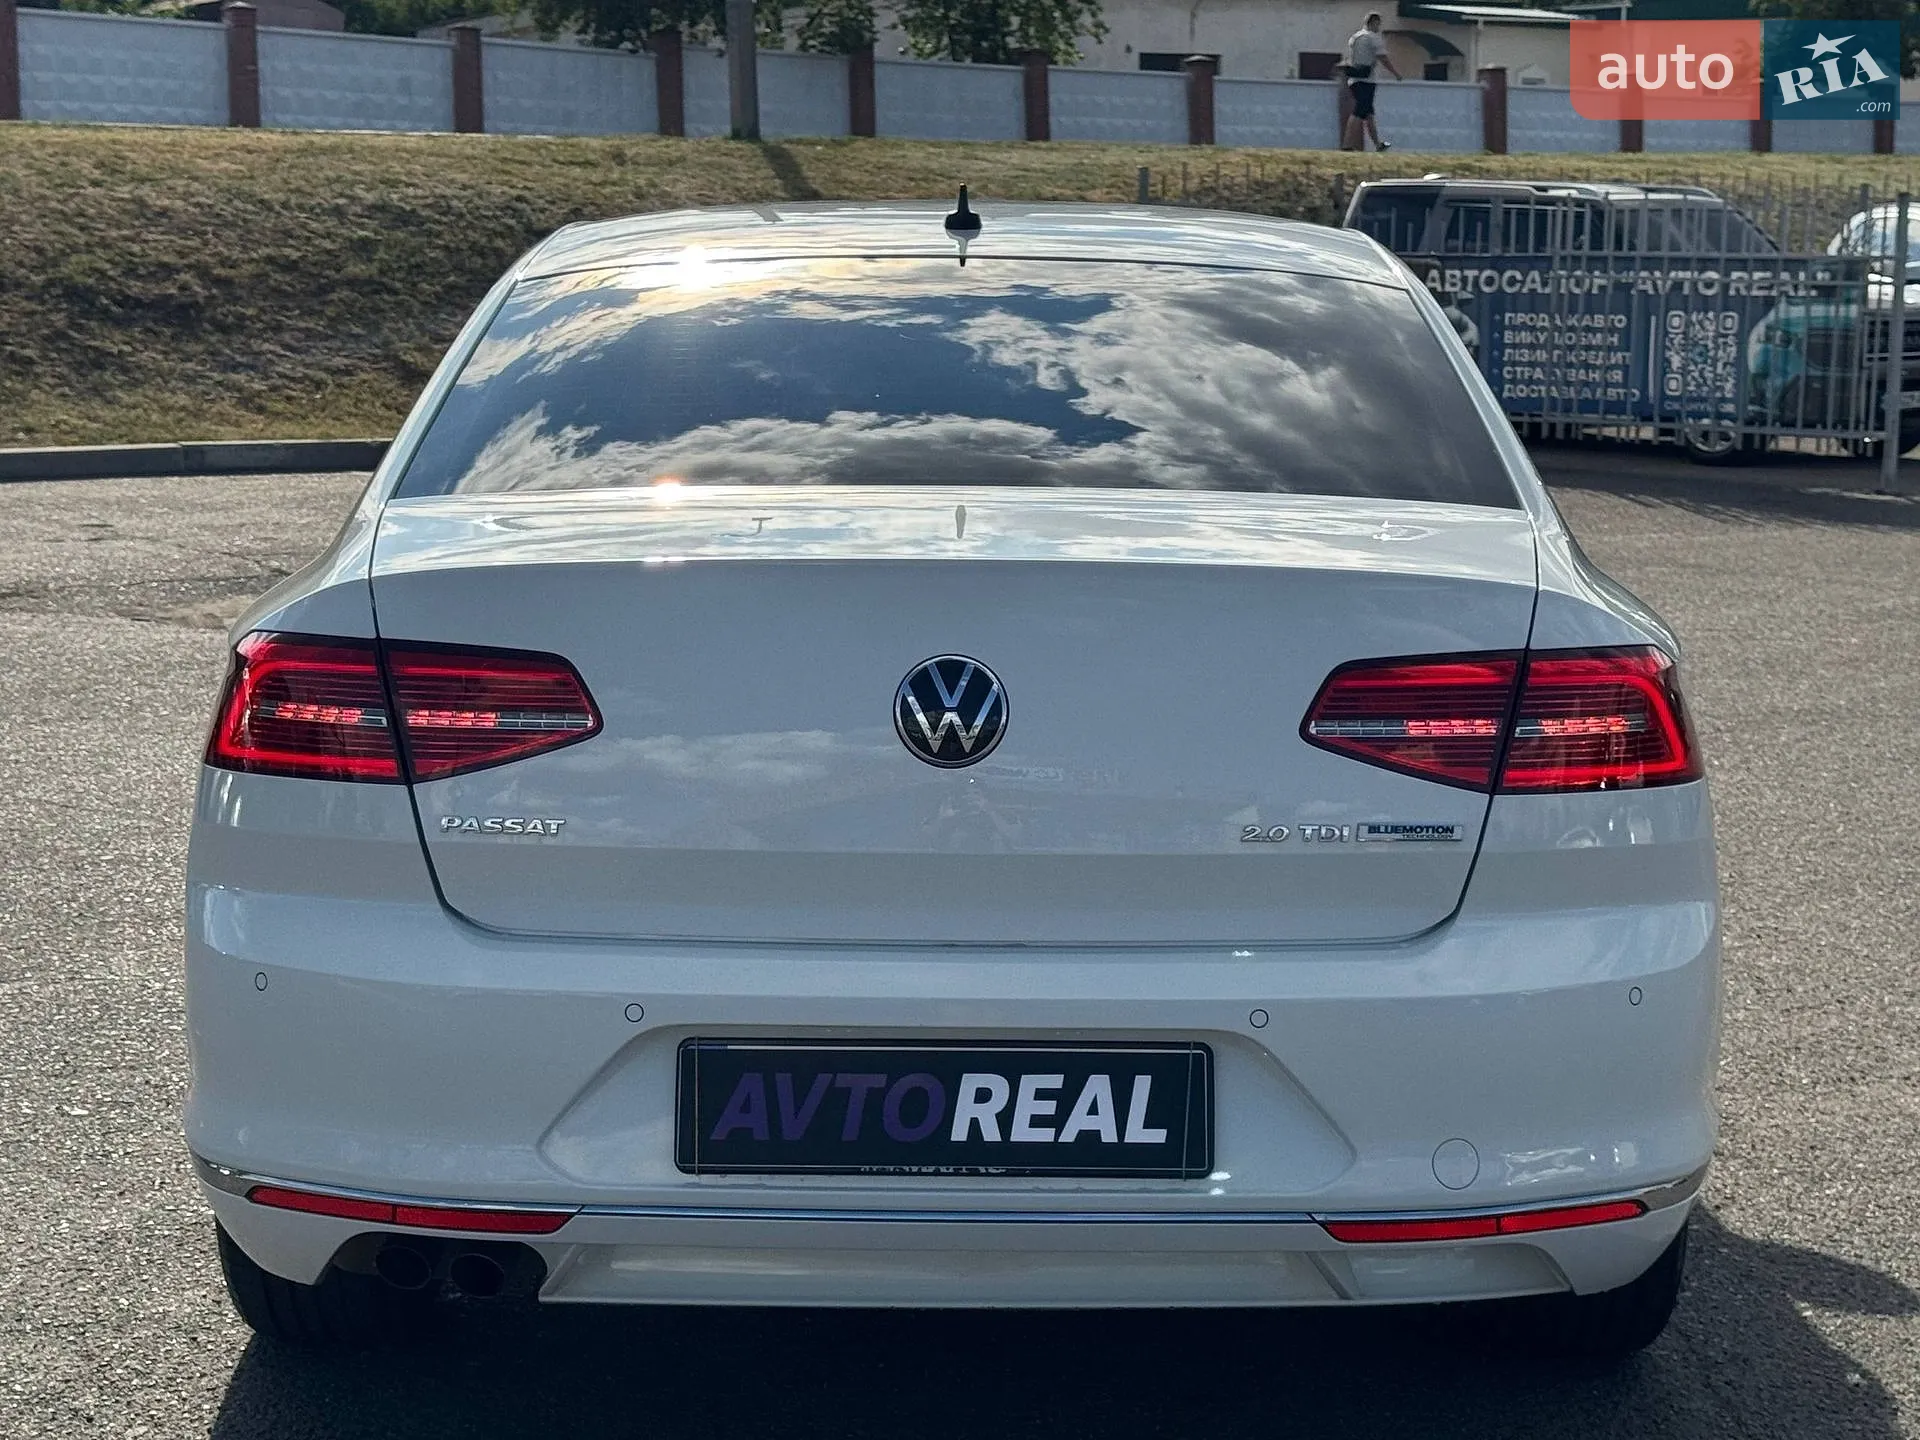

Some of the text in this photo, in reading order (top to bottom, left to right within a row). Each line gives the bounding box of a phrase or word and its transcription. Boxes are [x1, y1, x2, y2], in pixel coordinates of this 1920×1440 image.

[440, 815, 566, 836] PASSAT
[1241, 825, 1455, 842] 2.0 TDI BLUEMOTION
